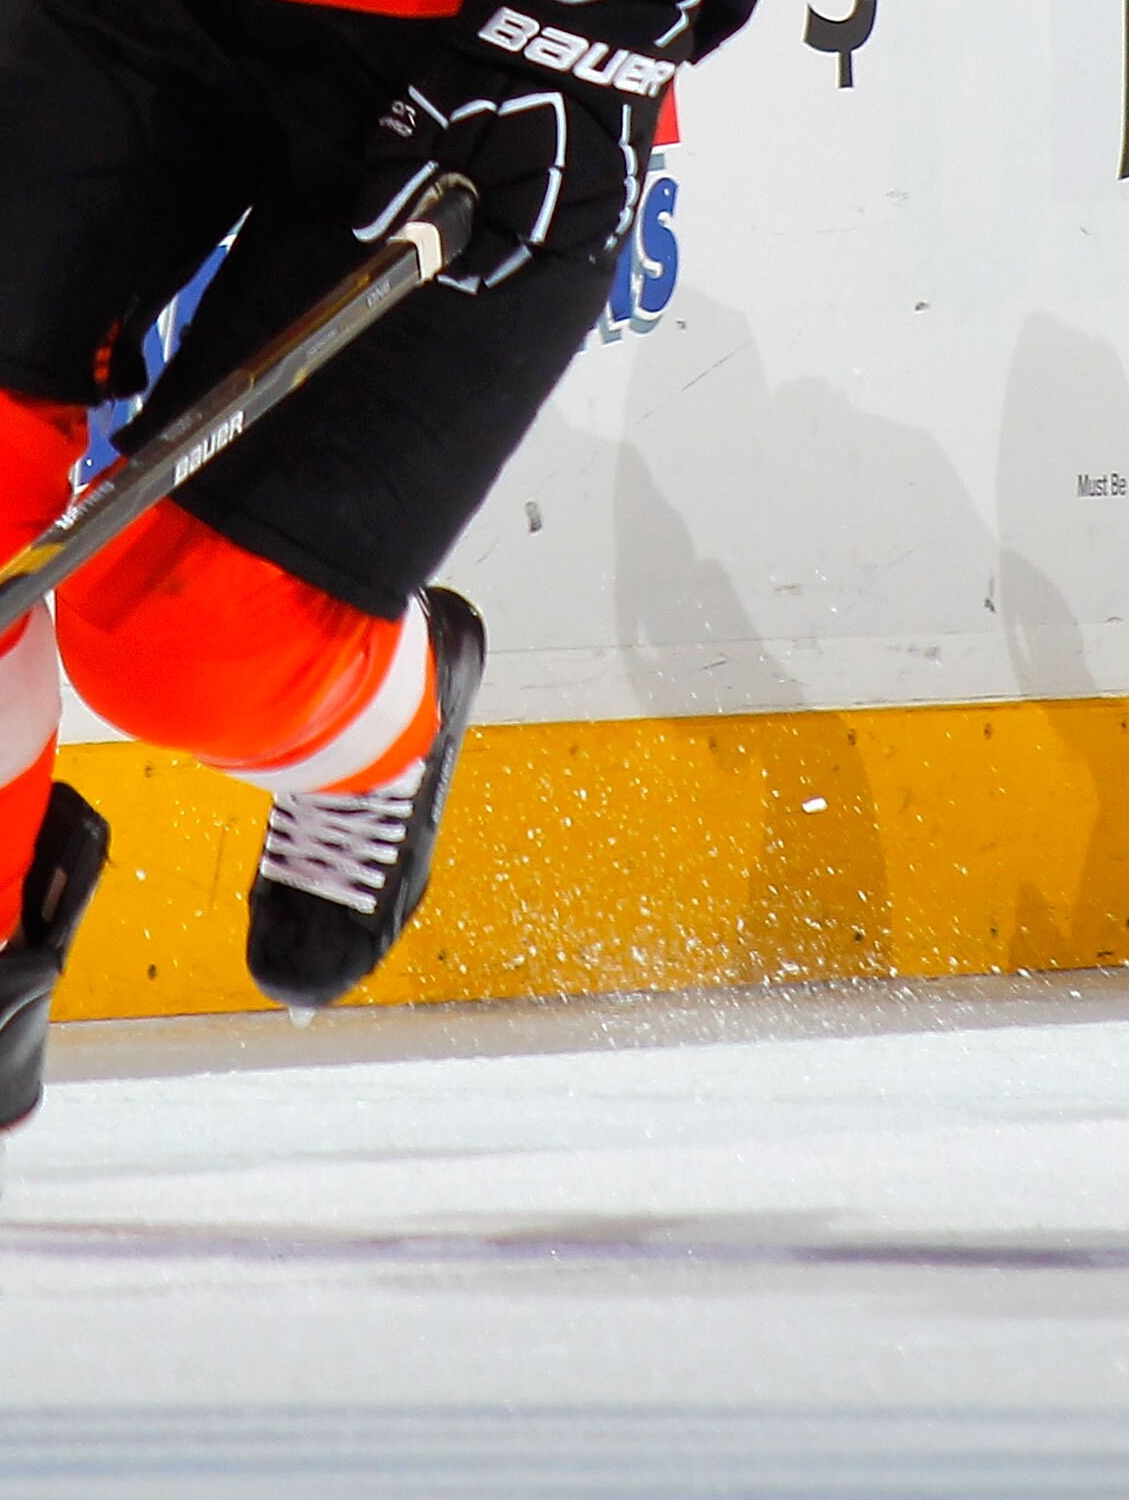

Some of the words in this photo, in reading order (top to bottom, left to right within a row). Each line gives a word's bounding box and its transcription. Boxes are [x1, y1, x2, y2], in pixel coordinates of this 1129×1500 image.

[477, 6, 676, 99] BAUER
[174, 410, 245, 488] BAUER
[1077, 473, 1108, 498] Must
